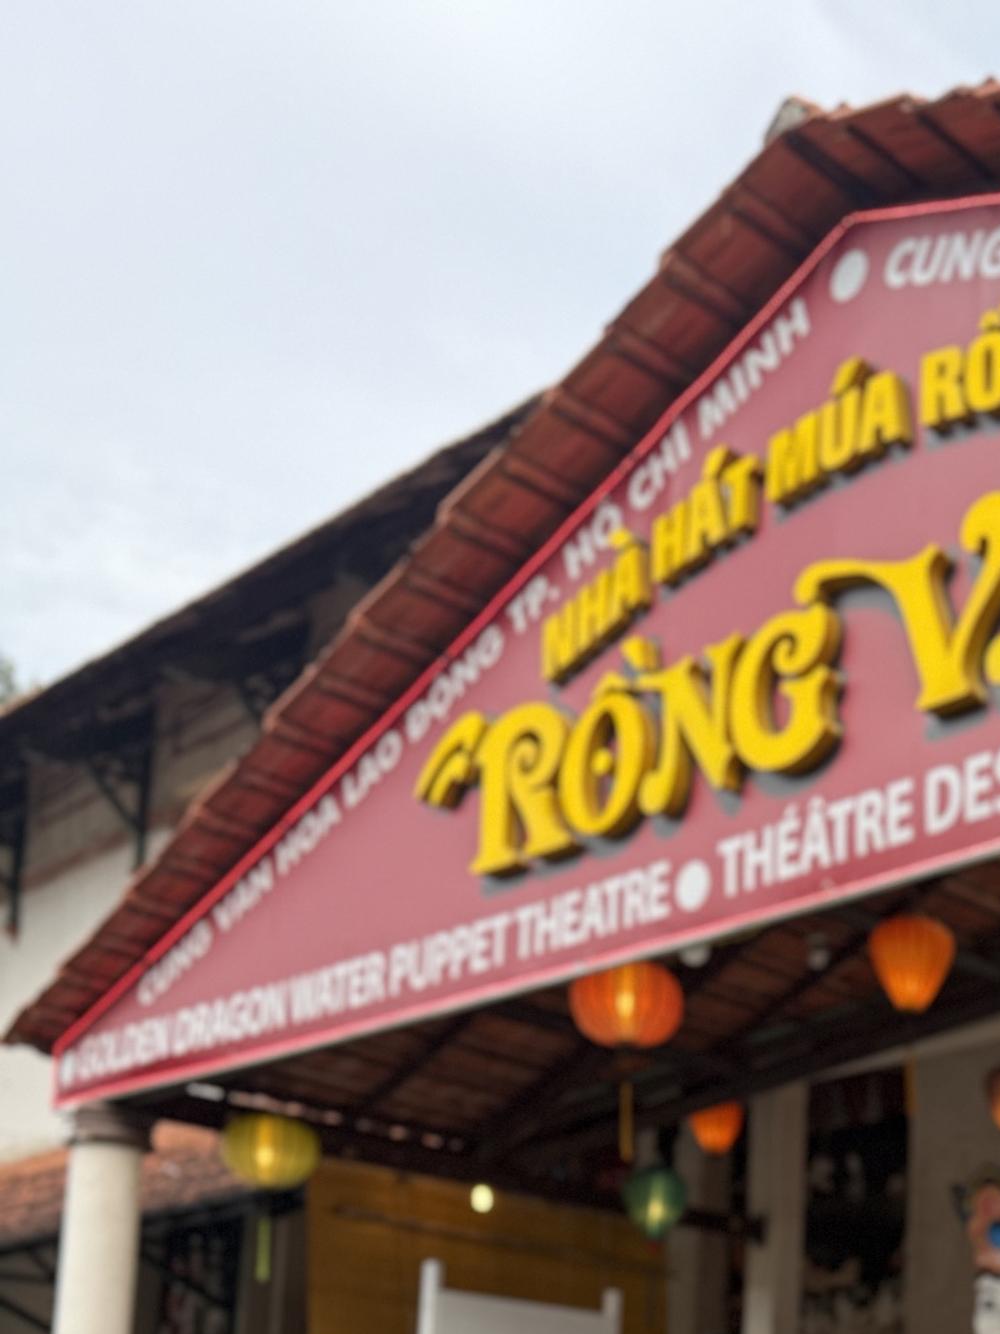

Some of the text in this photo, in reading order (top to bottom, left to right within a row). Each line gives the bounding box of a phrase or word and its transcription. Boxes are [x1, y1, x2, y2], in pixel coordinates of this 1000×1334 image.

[341, 729, 403, 810] LAO
[697, 297, 811, 438] MINH
[541, 526, 650, 686] NHÀ
[651, 445, 762, 588] HÁT
[766, 356, 908, 506] MÚA
[172, 980, 288, 1057] DRAGON
[288, 950, 387, 1024] WATER
[388, 908, 512, 997] PUPPET
[513, 860, 673, 961] THEATRE
[716, 777, 915, 898] THÉÂTRE
